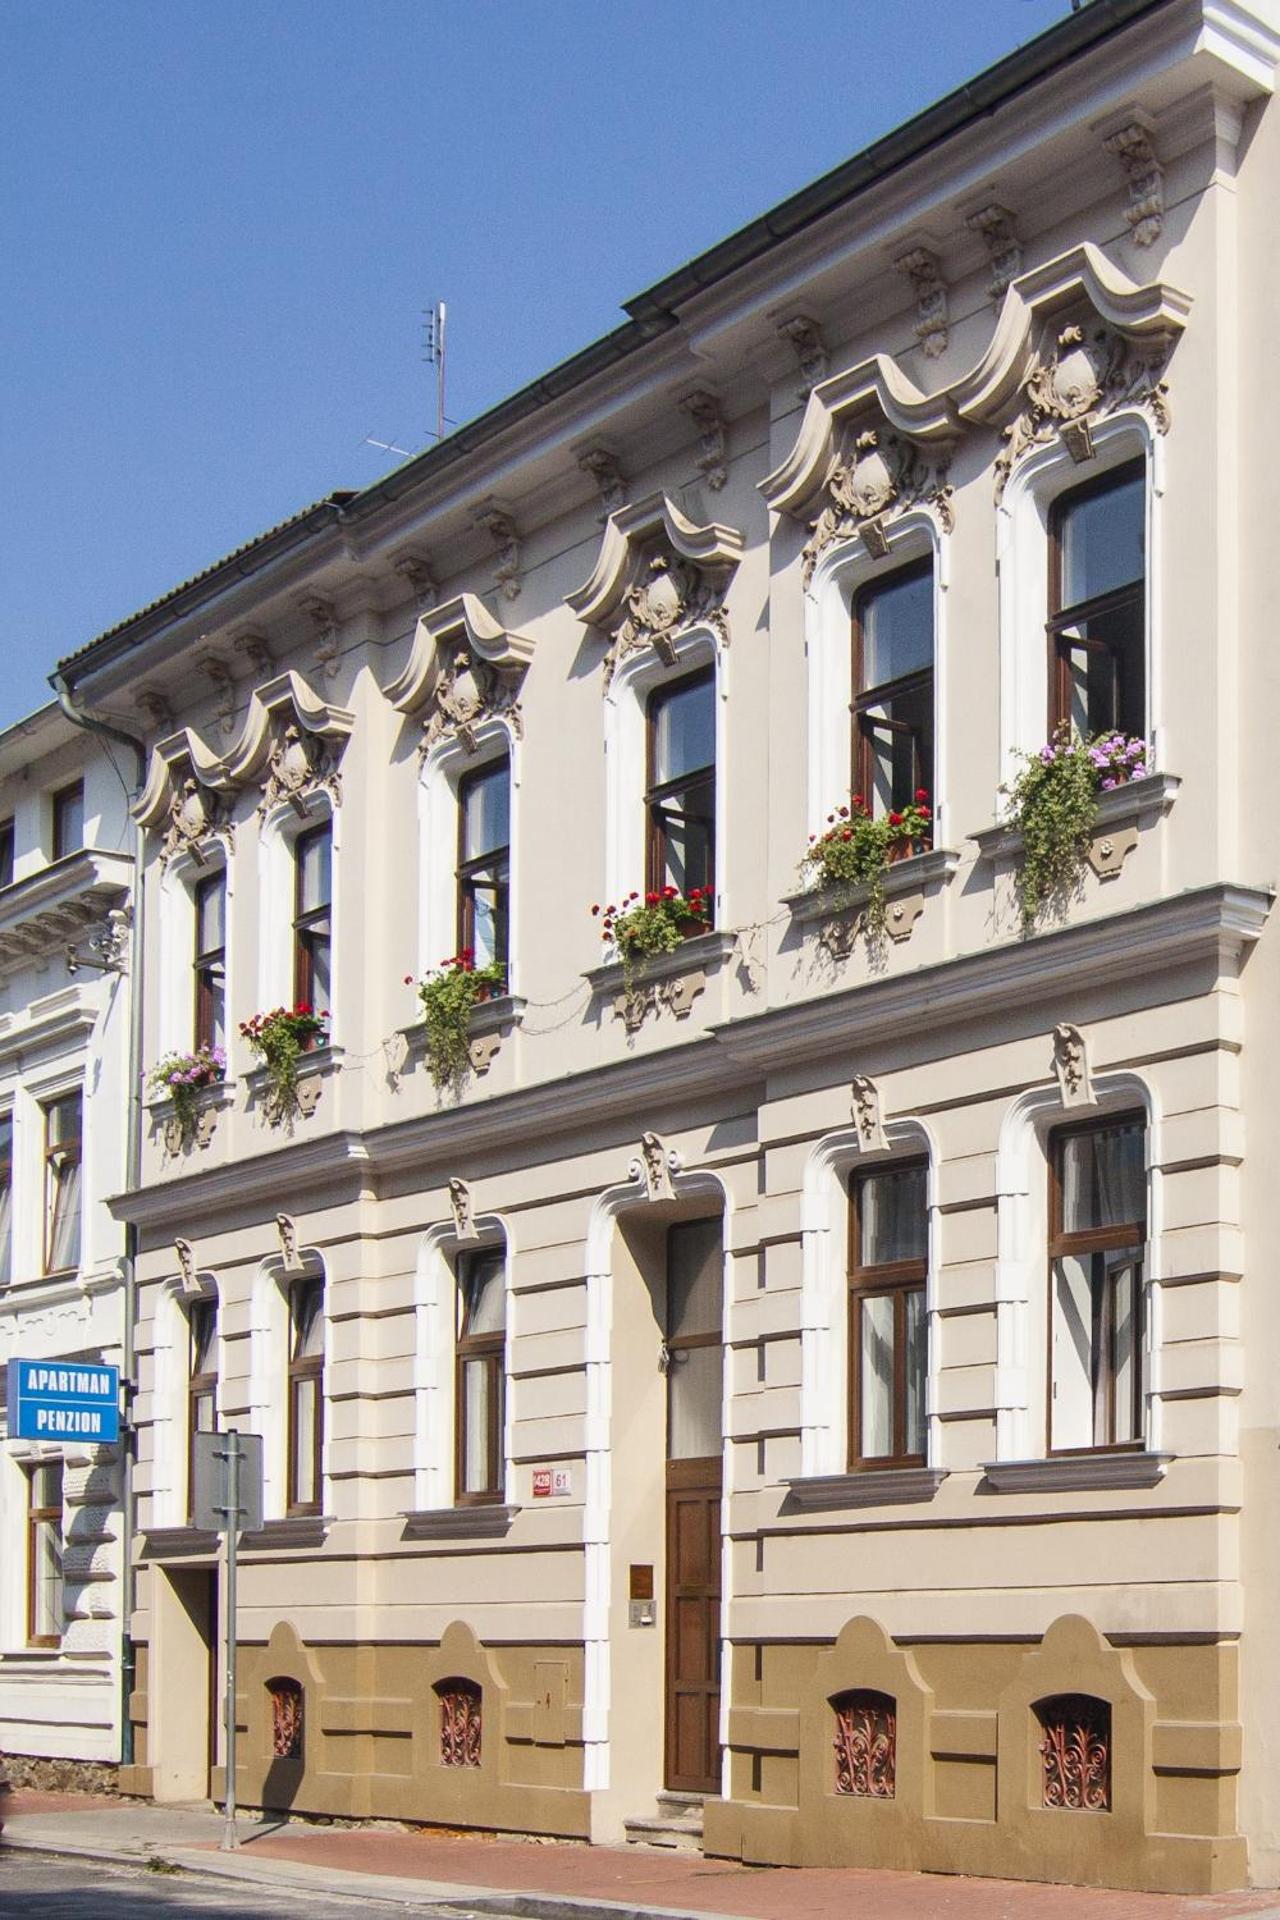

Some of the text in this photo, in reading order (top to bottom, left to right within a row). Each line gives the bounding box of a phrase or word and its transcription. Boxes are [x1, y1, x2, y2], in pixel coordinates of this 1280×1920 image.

[28, 1369, 110, 1394] APARTMAN
[37, 1409, 101, 1433] PENZION
[556, 1474, 567, 1487] 61
